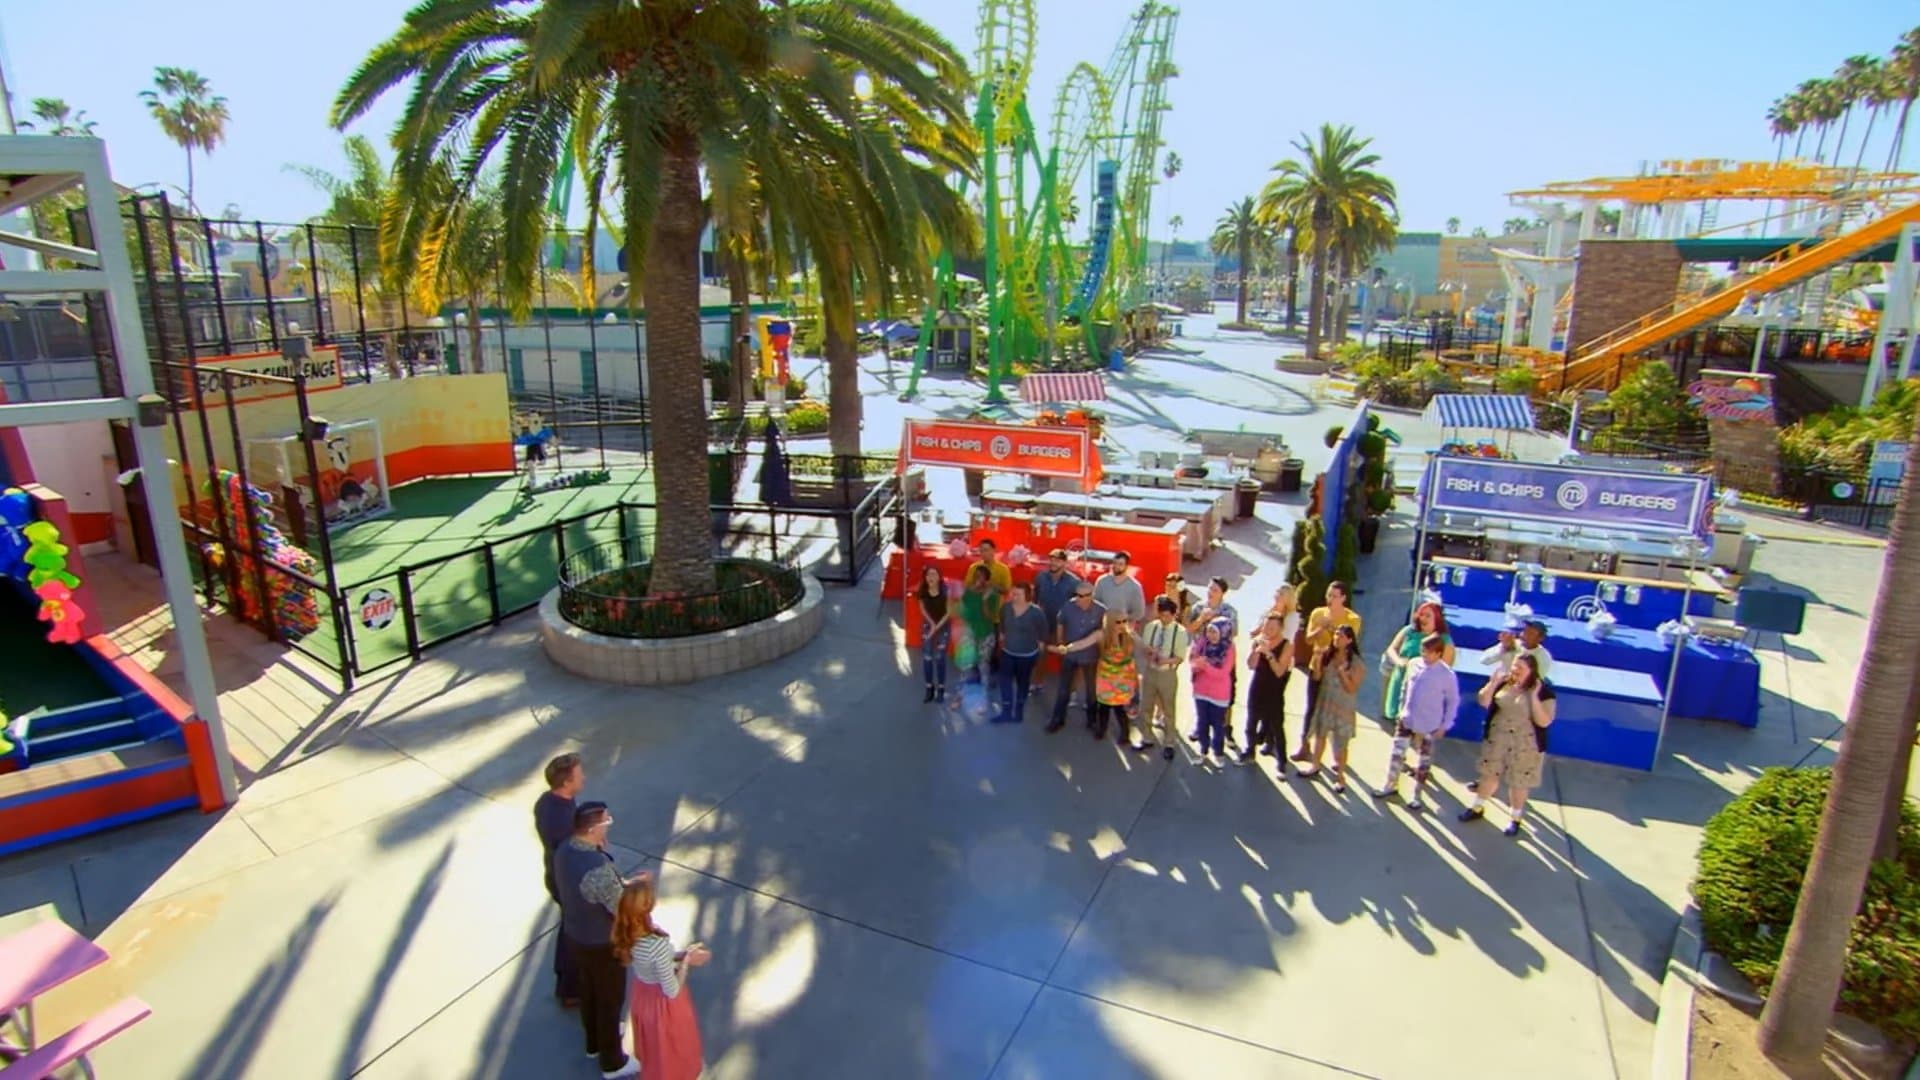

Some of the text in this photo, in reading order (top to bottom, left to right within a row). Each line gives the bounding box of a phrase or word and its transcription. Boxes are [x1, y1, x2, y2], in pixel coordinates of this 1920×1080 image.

[915, 436, 982, 451] FISH & CHIPS
[1018, 444, 1072, 459] BURGERS
[1446, 478, 1545, 498] FISH & CHIPS
[1599, 492, 1677, 511] BURGERS
[363, 599, 393, 620] EXIT
